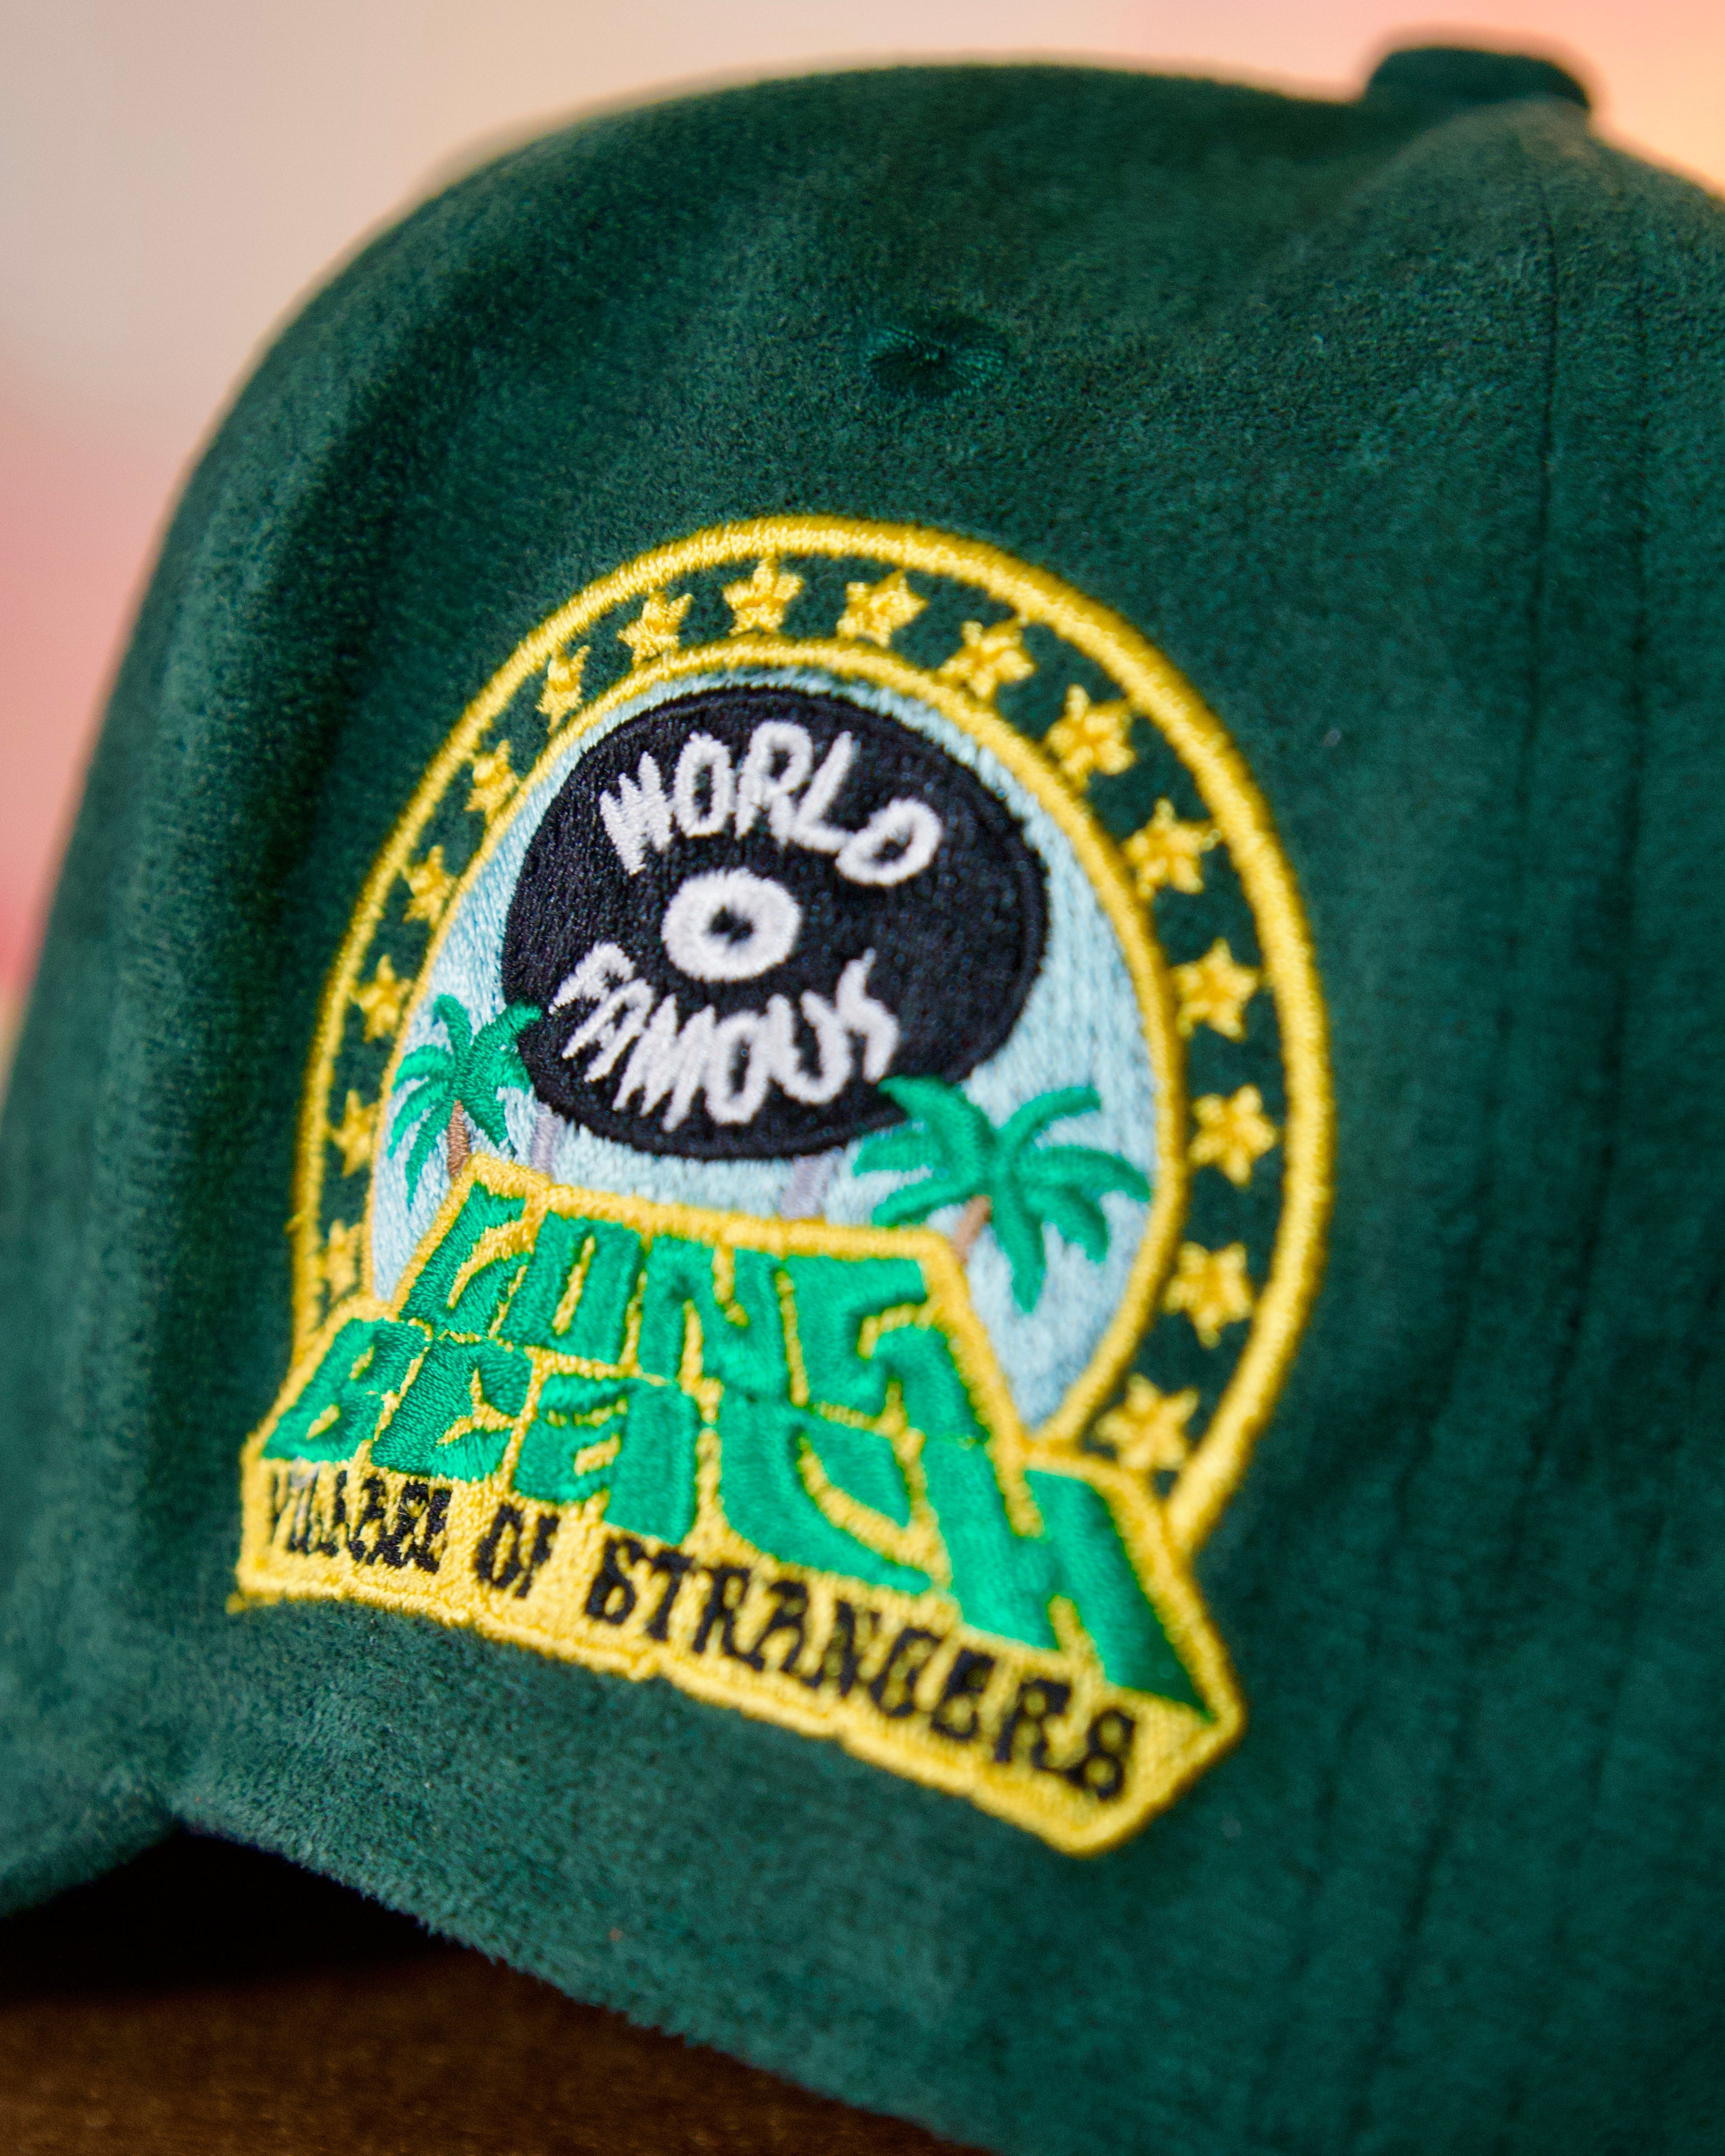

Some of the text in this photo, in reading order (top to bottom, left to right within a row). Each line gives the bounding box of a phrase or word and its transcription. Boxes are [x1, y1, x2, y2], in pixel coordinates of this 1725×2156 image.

[598, 720, 943, 886] WORLD
[548, 941, 898, 1133] FAMOUS
[474, 1502, 561, 1598] OF
[585, 1535, 1136, 1802] STRANGERS
